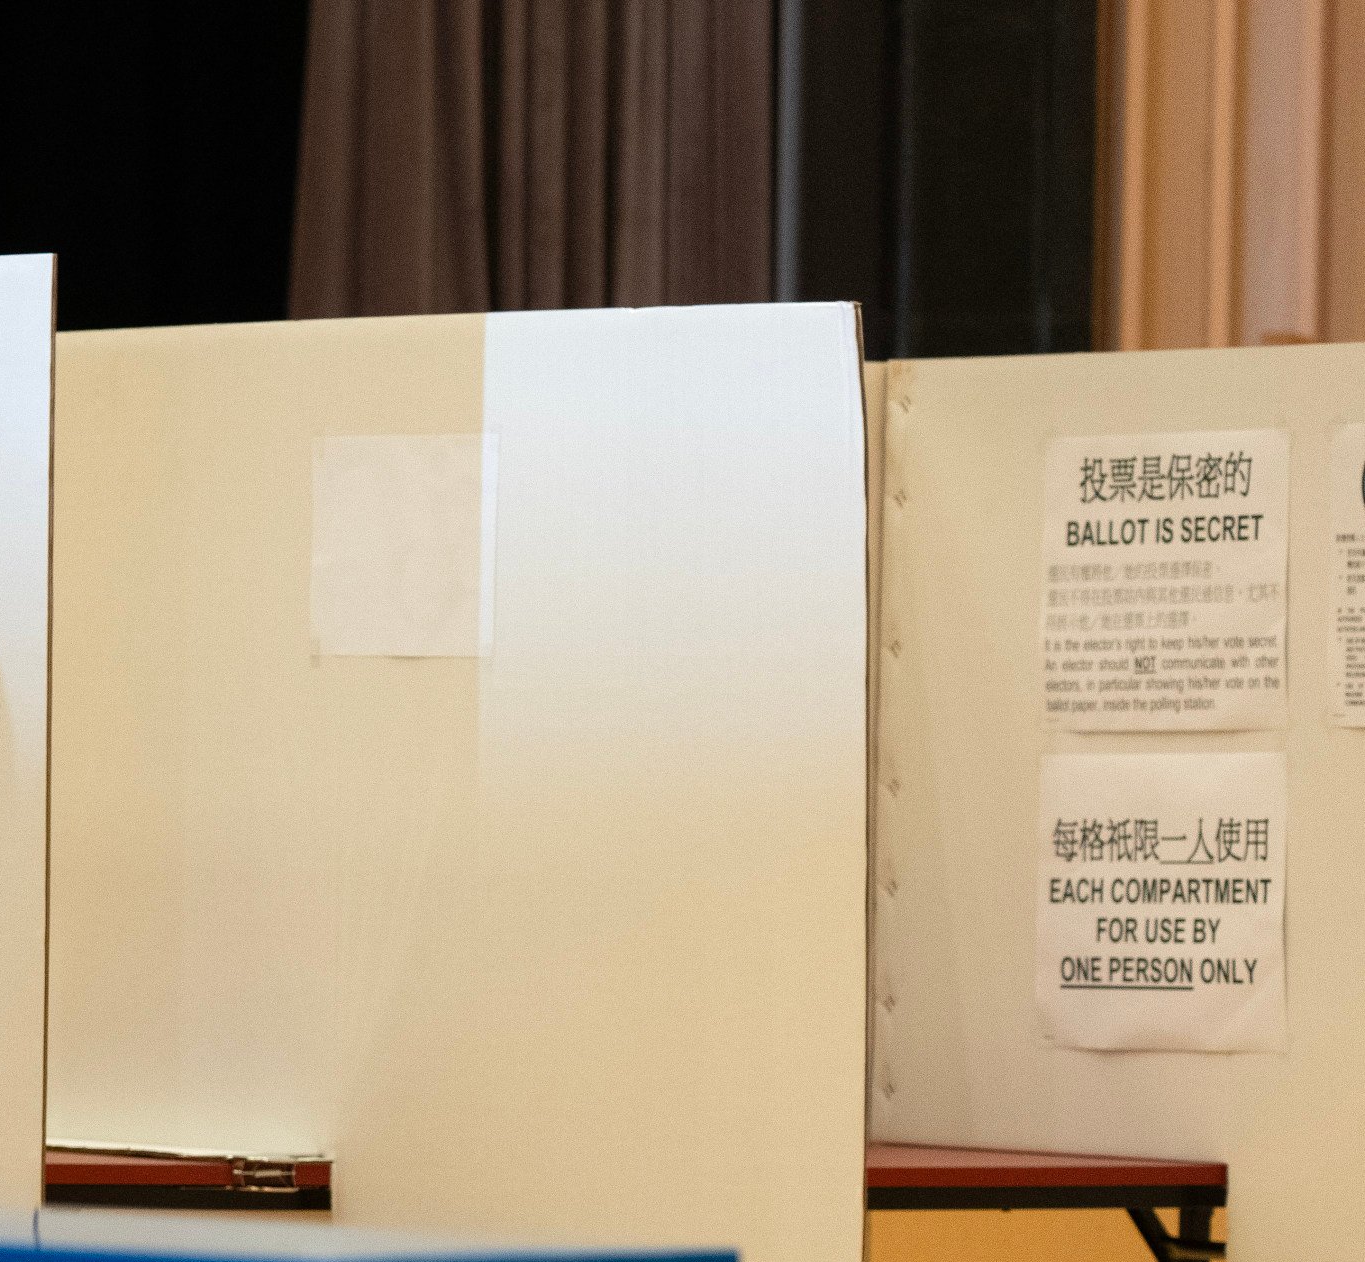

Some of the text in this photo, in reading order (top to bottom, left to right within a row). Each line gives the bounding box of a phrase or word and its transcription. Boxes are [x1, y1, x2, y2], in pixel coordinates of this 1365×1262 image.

[1080, 450, 1253, 504] 投票是保密的
[1066, 514, 1264, 547] BALLOT IS SECRET
[1134, 655, 1156, 669] NOT
[1049, 878, 1272, 905] EACH COMPARTMENT
[1096, 917, 1221, 944] FOR USE BY
[1061, 956, 1258, 985] ONE PERSON ONLY
